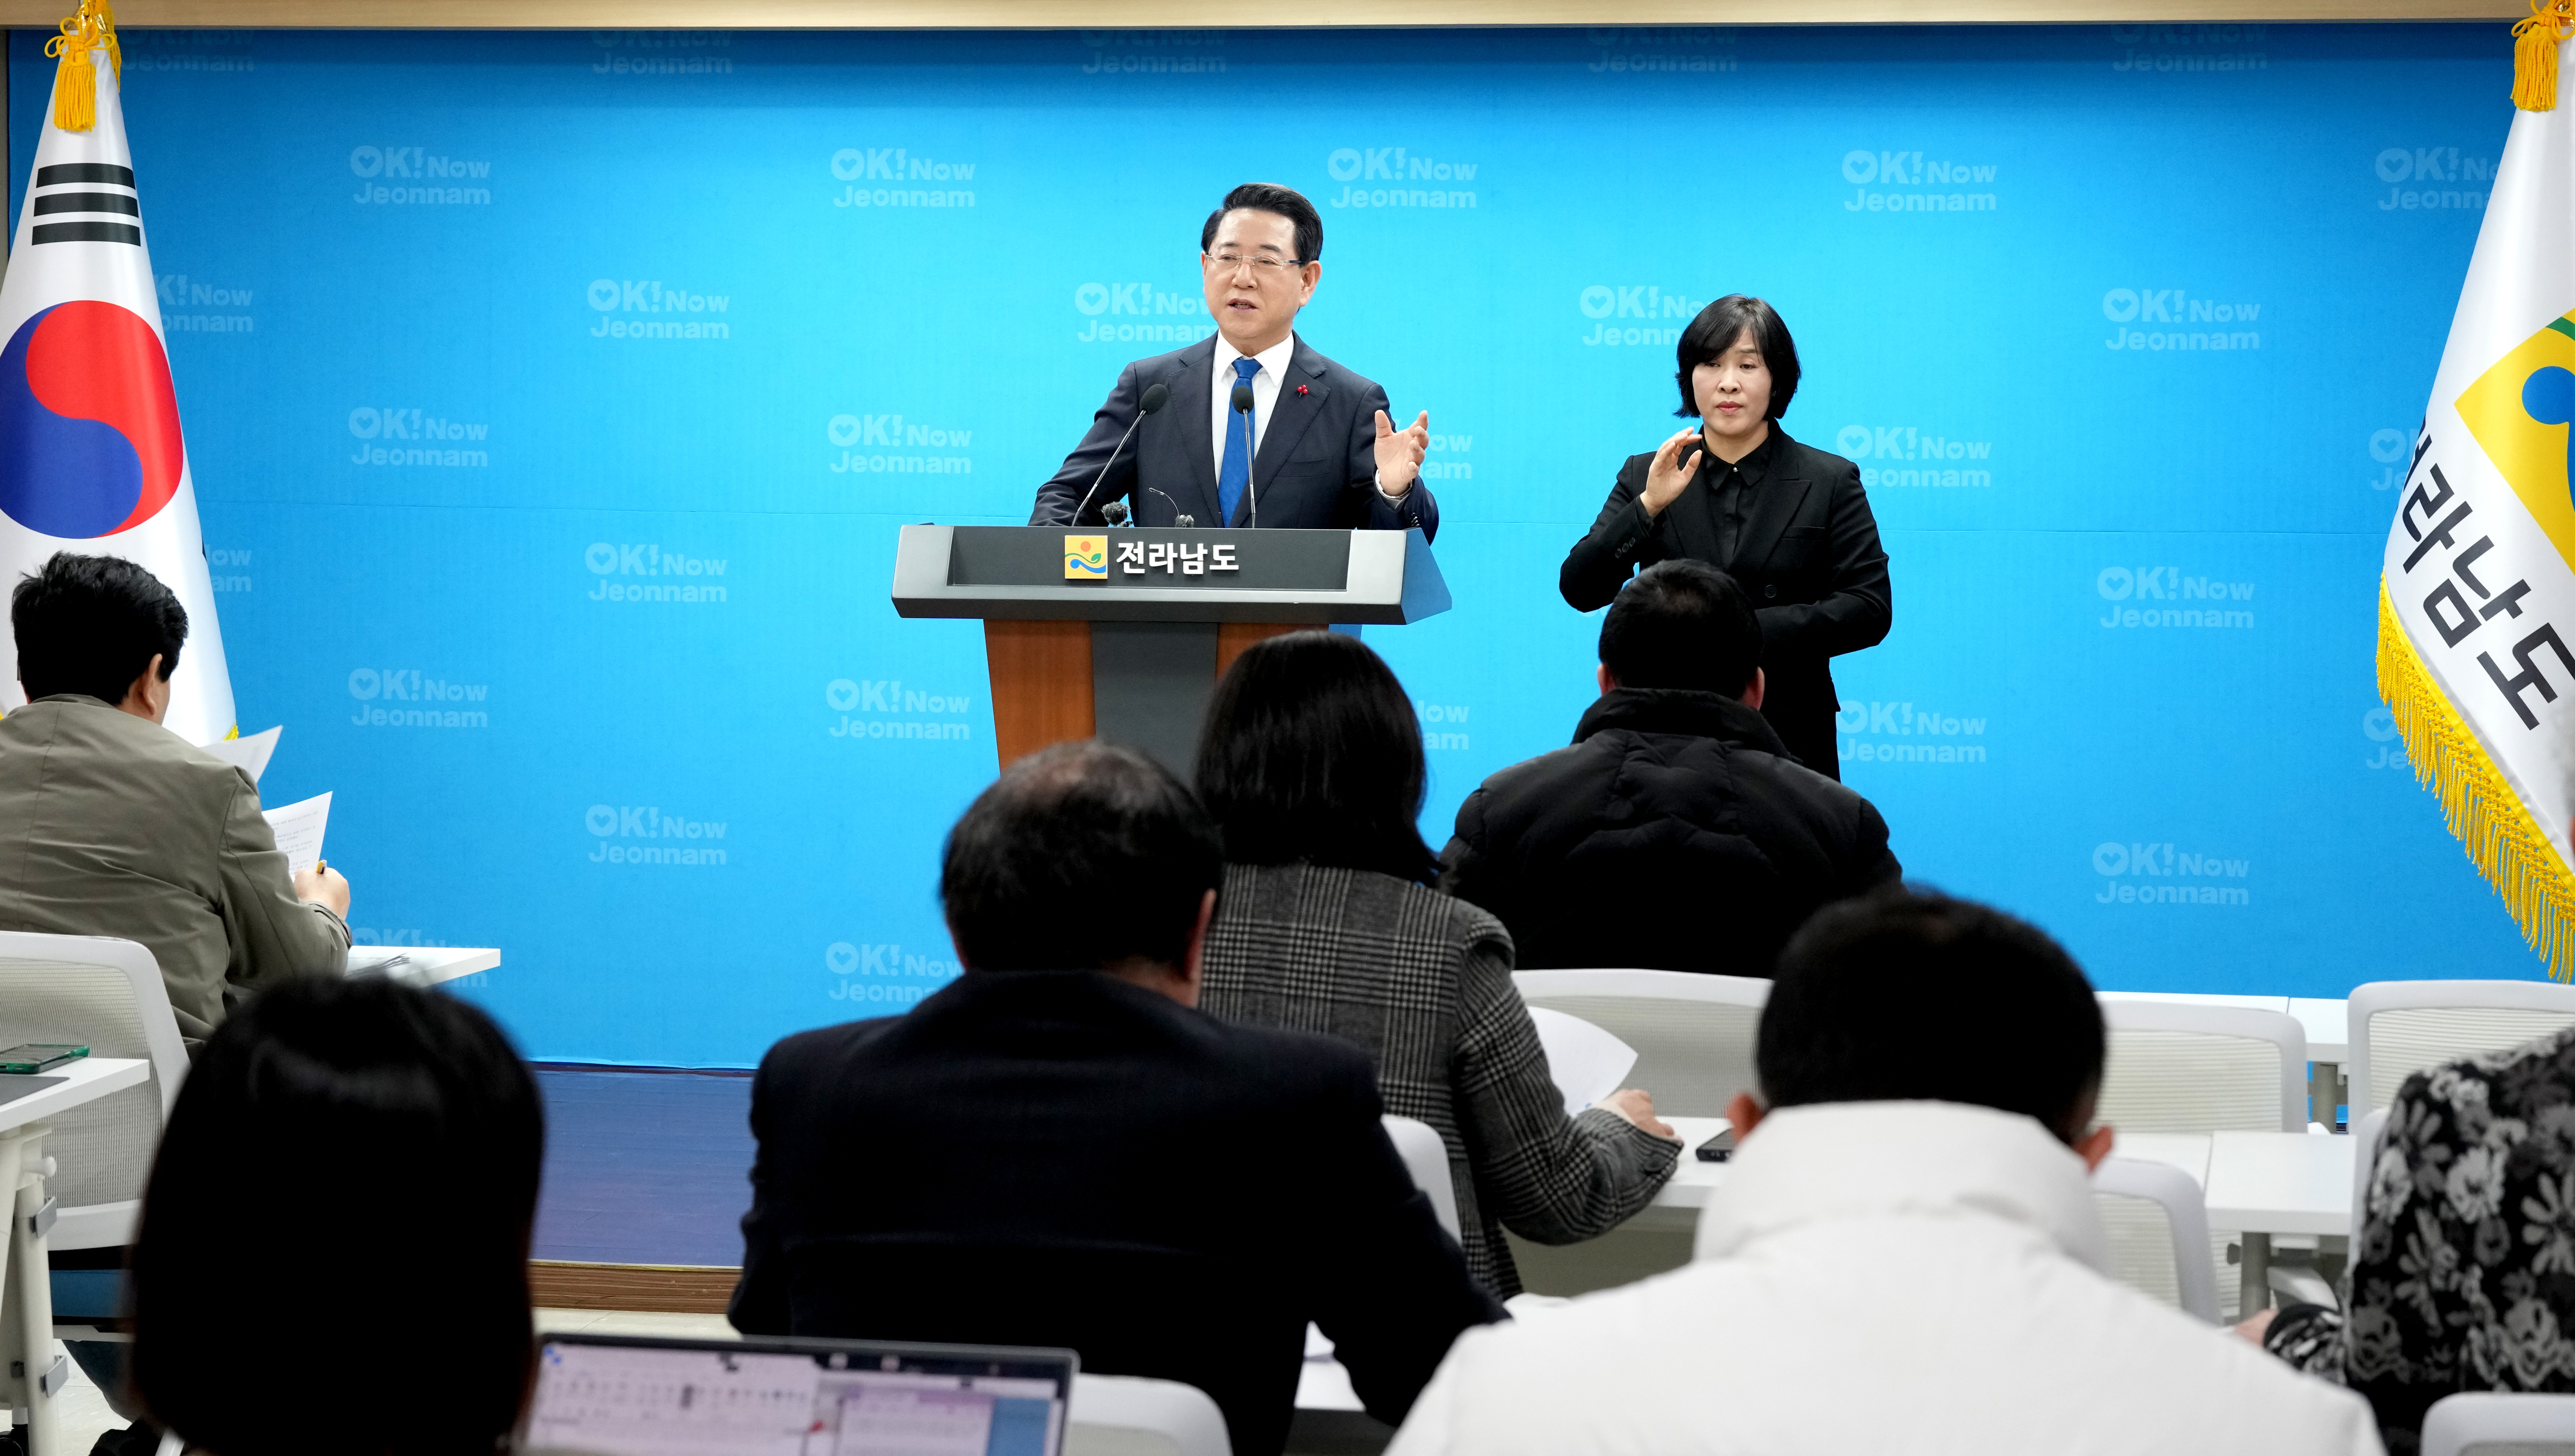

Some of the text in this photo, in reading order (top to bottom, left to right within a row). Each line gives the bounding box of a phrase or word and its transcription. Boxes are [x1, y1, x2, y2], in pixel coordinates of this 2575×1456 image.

[593, 51, 732, 74] Jeonnam
[1082, 51, 1226, 73] Jeonnam
[1588, 50, 1737, 72] Jeonnam
[2112, 49, 2268, 72] Jeonnam
[350, 145, 425, 179] OK!
[831, 148, 907, 181] OK!
[1328, 147, 1406, 182] OK!
[1842, 149, 1923, 186] OK!
[2375, 147, 2460, 183] OK!
[352, 182, 491, 205] Jeonnam
[833, 186, 976, 208] Jeonnam
[1331, 186, 1477, 208] Jeonnam
[1844, 188, 1997, 212] Jeonnam
[2378, 187, 2488, 210] Jeonn
[153, 274, 188, 306] K!
[588, 279, 662, 312] OK!
[1075, 282, 1152, 316] OK!
[1580, 285, 1660, 319] OK!
[2103, 288, 2186, 323] OK!
[162, 314, 254, 332] onnam
[590, 316, 729, 339] Jeonnam
[1582, 323, 1682, 346] Jeonn
[2105, 326, 2260, 350] Jeonnam
[348, 407, 422, 440] OK!
[828, 413, 903, 447] OK!
[350, 443, 489, 467] Jeonnam
[1837, 425, 1918, 461] OK!
[829, 450, 972, 473] Jeonnam
[1859, 468, 1991, 487] eonnam
[585, 543, 659, 576] OK!
[1116, 541, 1239, 575] 전라남도
[587, 579, 727, 602] Jeonnam
[2097, 566, 2179, 601] OK!
[2099, 605, 2255, 629] Jeonnam
[348, 668, 421, 702] OK!
[826, 678, 901, 713] OK!
[350, 705, 488, 728] Jeonnam
[829, 715, 970, 740] Jeonnam
[1836, 700, 1913, 736] OK!
[1838, 739, 1987, 763] Jeonnam
[585, 804, 660, 838] OK!
[587, 841, 727, 865] Jeonnam
[2092, 842, 2175, 877] OK!
[2095, 880, 2250, 906] Jeonnam
[826, 942, 900, 976] OK!
[829, 979, 932, 1002] Jeonn
